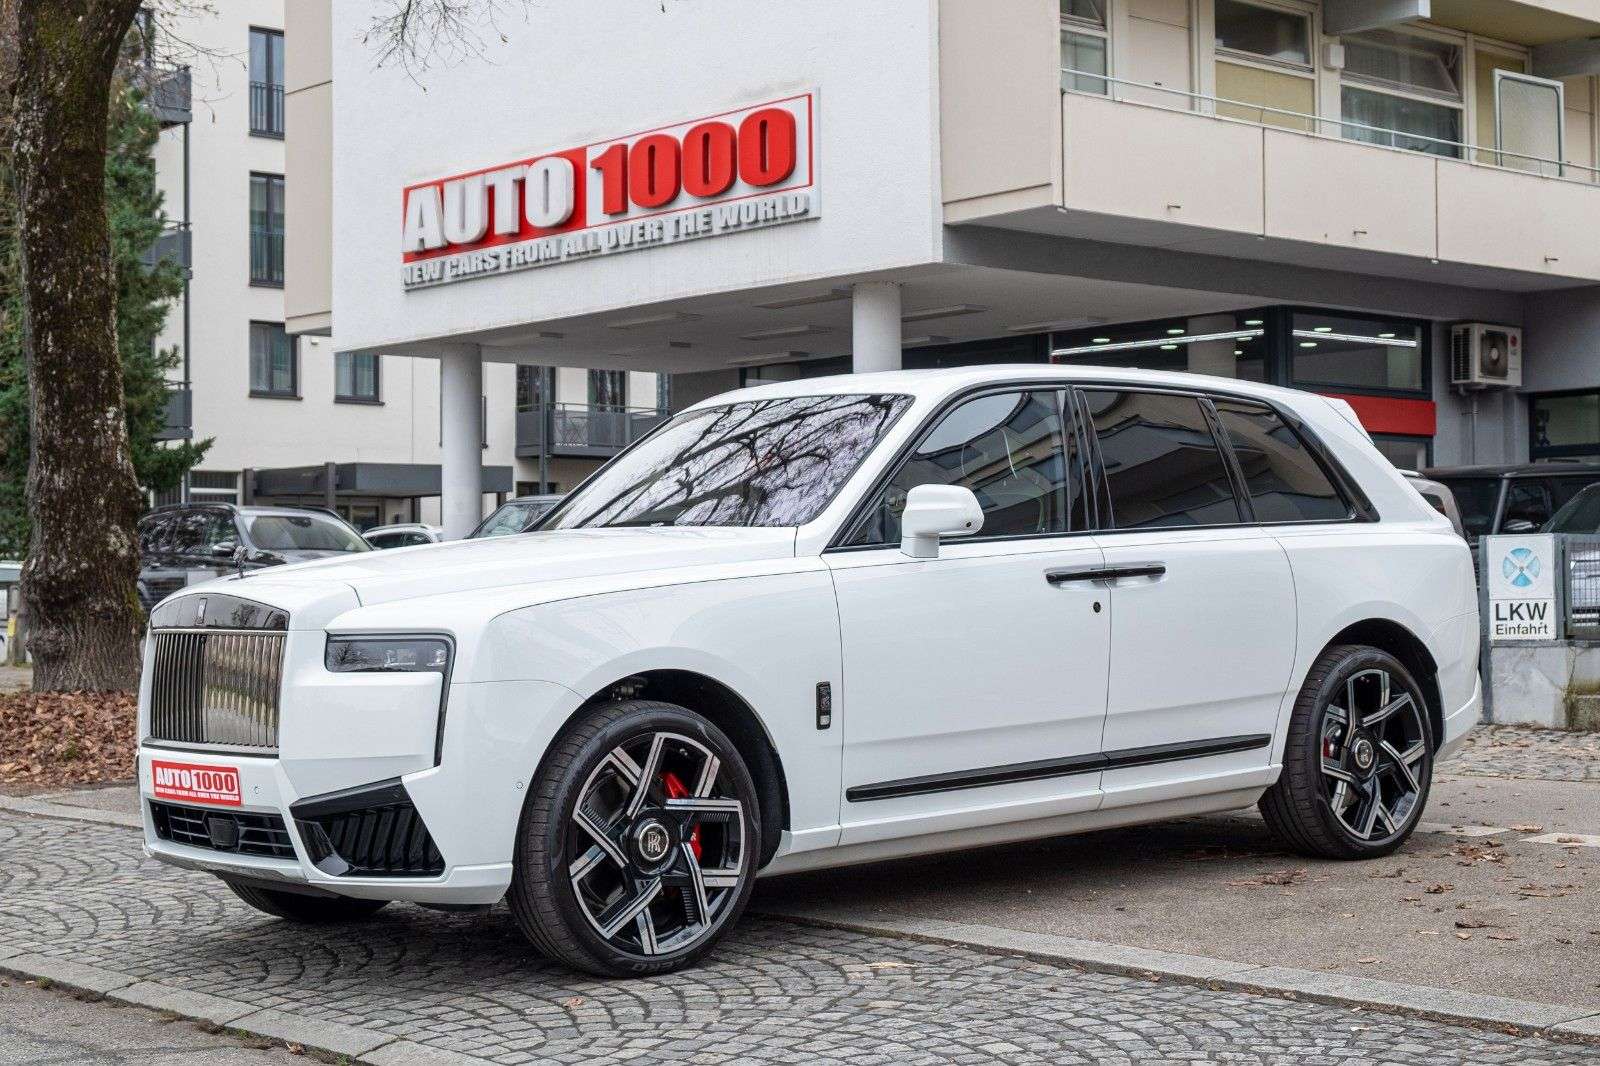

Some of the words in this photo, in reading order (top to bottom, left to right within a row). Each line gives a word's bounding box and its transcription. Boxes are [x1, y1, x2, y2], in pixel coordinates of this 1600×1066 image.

[404, 156, 574, 252] AUTO
[591, 107, 797, 216] 1000
[448, 250, 500, 277] CARS
[501, 239, 557, 269] FROM
[561, 229, 600, 258] ALL
[604, 219, 664, 250] OVER
[665, 209, 713, 239] THE
[716, 193, 810, 229] WORLD
[1495, 602, 1548, 621] LKW
[1496, 622, 1549, 635] Einfahrt
[155, 767, 191, 788] AUTO
[193, 771, 236, 792] 1000
